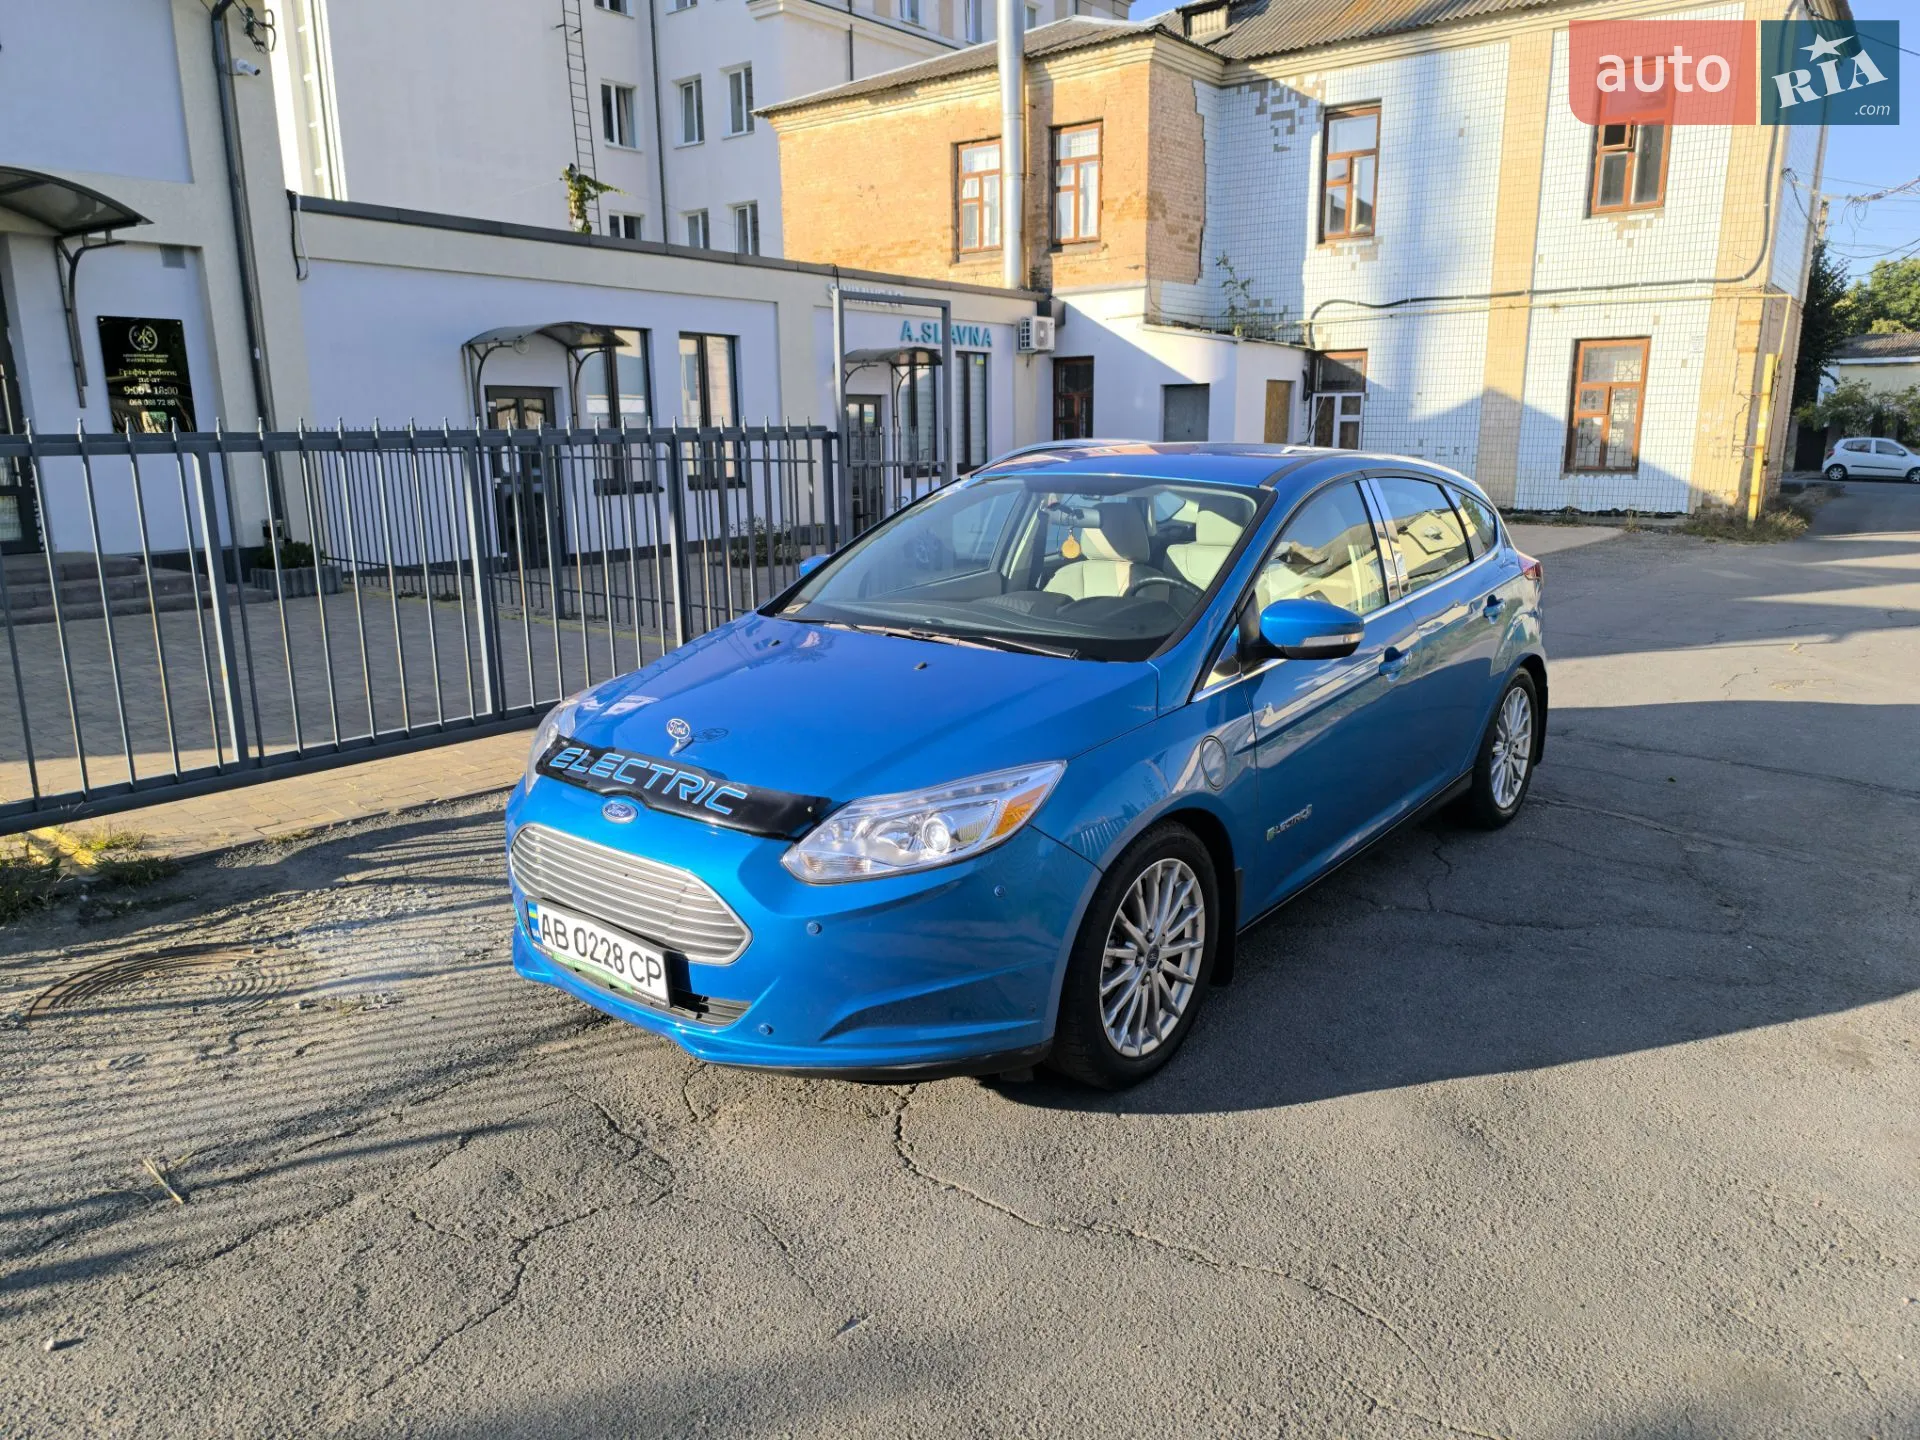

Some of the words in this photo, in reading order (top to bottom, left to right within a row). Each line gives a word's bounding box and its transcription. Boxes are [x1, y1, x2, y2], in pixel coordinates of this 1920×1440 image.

[153, 386, 178, 395] 18:00
[667, 719, 686, 735] Ford
[550, 747, 748, 815] ELECTRIC
[541, 913, 569, 951] AB
[573, 927, 625, 975] 0228
[629, 950, 662, 988] CP
